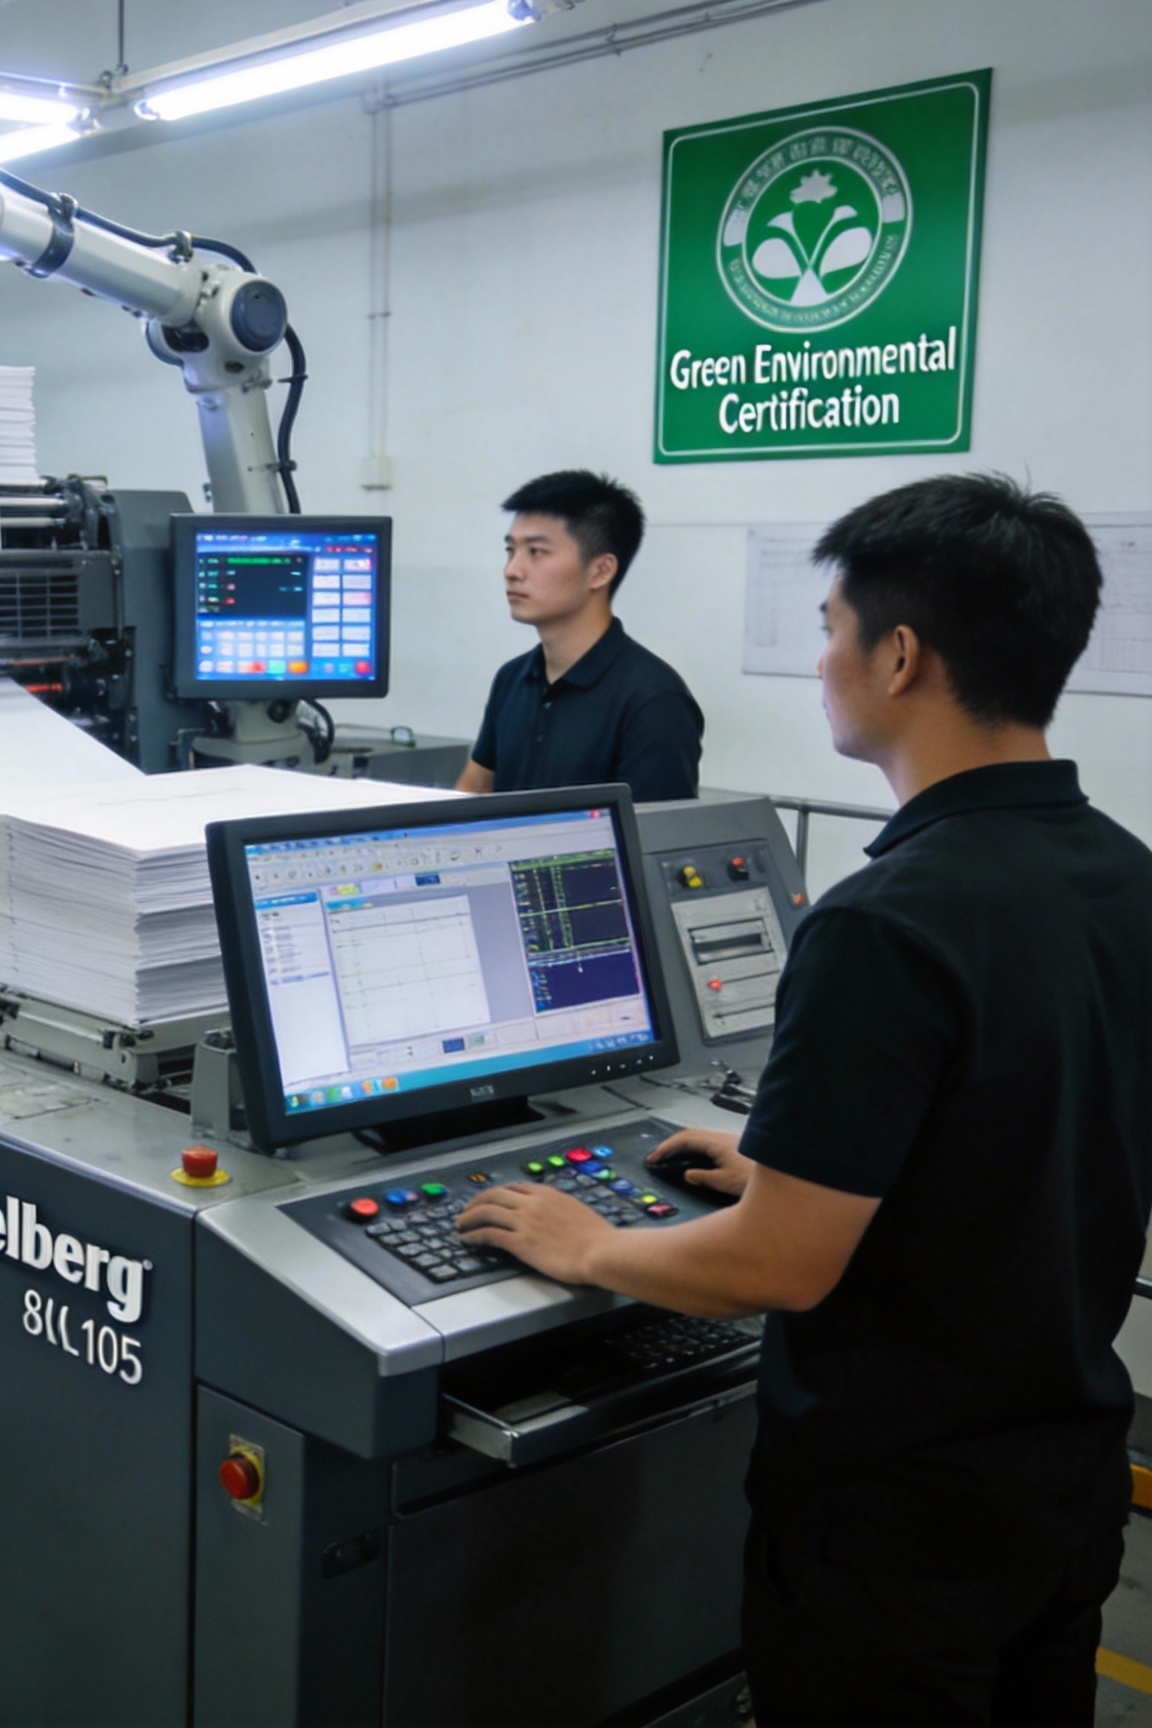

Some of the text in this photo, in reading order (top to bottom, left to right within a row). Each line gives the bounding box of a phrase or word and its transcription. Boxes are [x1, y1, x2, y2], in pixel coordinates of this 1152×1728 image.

[670, 326, 956, 389] Green Environmental
[719, 385, 899, 433] Certification
